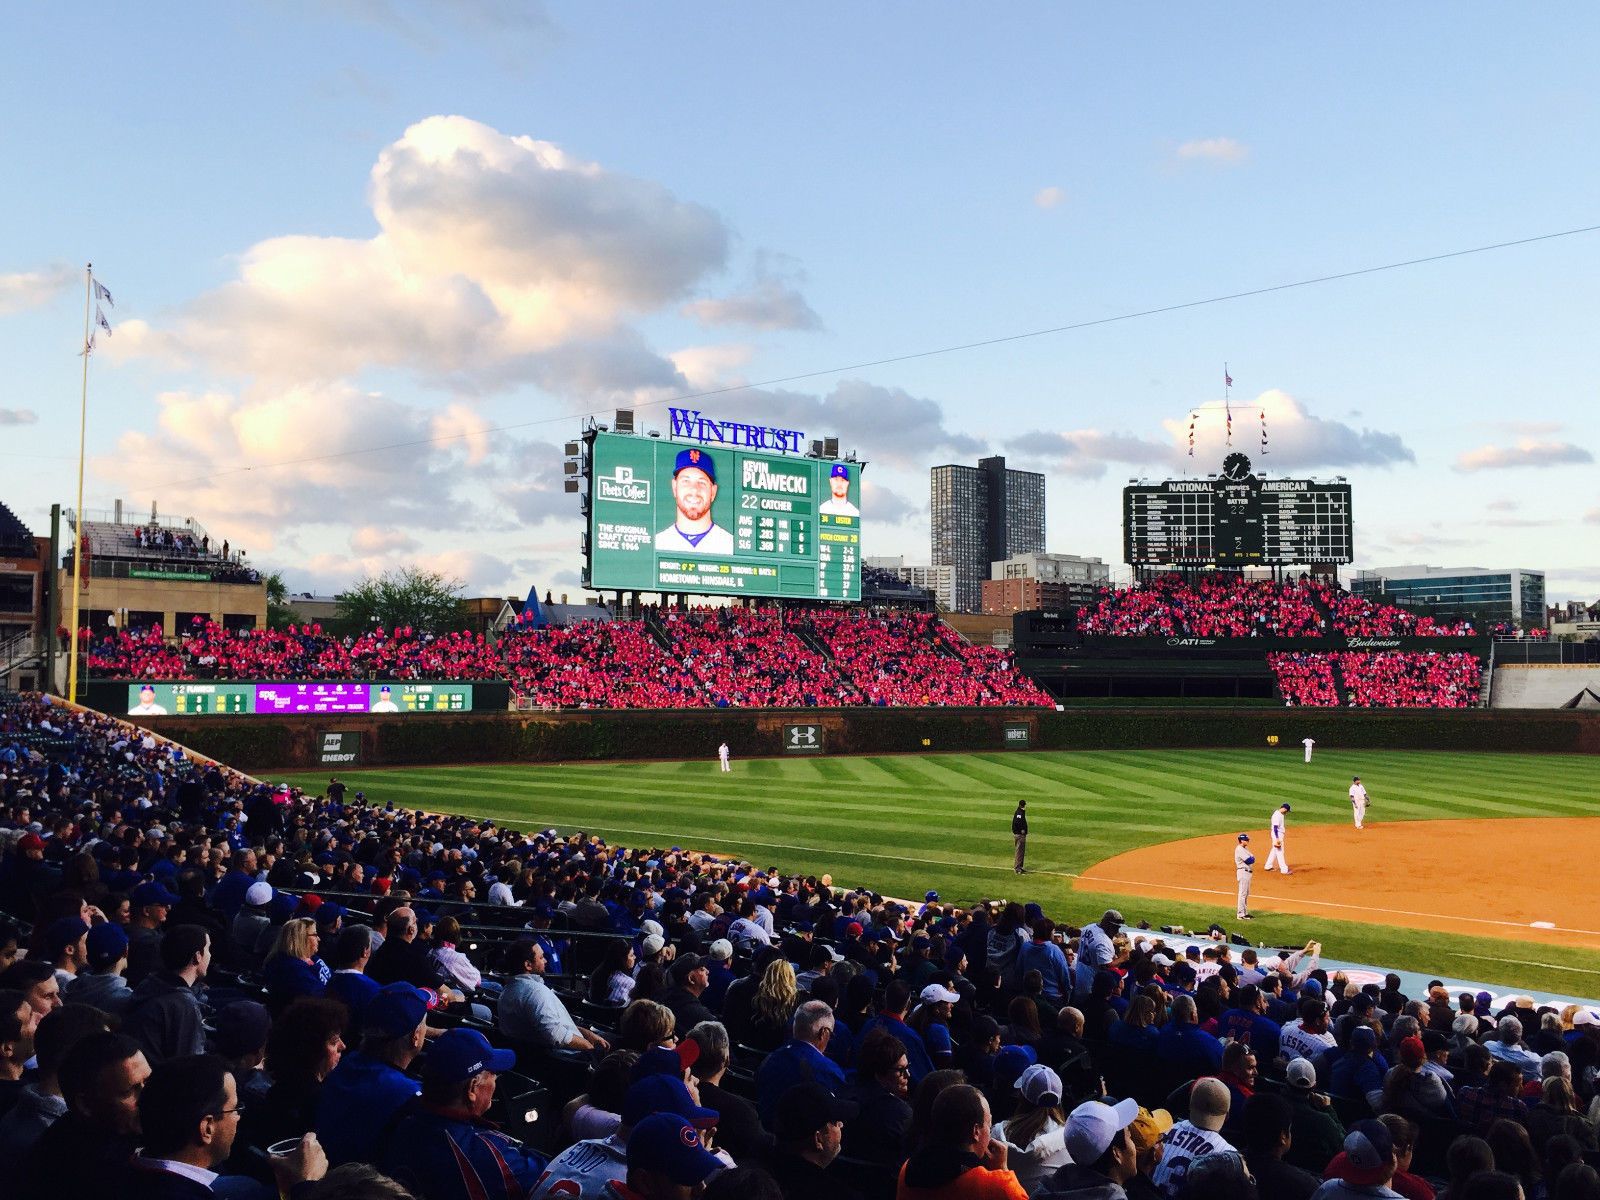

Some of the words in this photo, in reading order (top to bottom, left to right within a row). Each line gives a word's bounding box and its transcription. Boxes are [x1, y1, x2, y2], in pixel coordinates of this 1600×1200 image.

[668, 407, 804, 453] WINTRUST
[743, 460, 768, 473] KEVIN
[743, 472, 807, 494] PLAWECKI
[1168, 483, 1214, 492] NATIONAL
[1261, 482, 1308, 491] AMERICAN
[623, 485, 647, 500] Coffee
[741, 494, 758, 509] 22
[761, 499, 792, 512] CATCHER
[1230, 505, 1245, 515] 22
[598, 523, 614, 532] THE
[614, 525, 649, 535] ORIGINAL
[798, 521, 804, 531] 1
[598, 532, 622, 542] CRAFT
[623, 534, 652, 544] COFFEE
[798, 532, 804, 543] 6
[598, 541, 620, 550] SINCE
[621, 542, 640, 552] 1966
[798, 543, 804, 554] 5
[1235, 540, 1242, 550] 2
[659, 573, 701, 585] HOMETOWN:
[1179, 638, 1199, 646] ATI
[1346, 637, 1402, 648] Budweiser
[321, 753, 356, 762] ENERGY
[1281, 1035, 1313, 1058] LESTER
